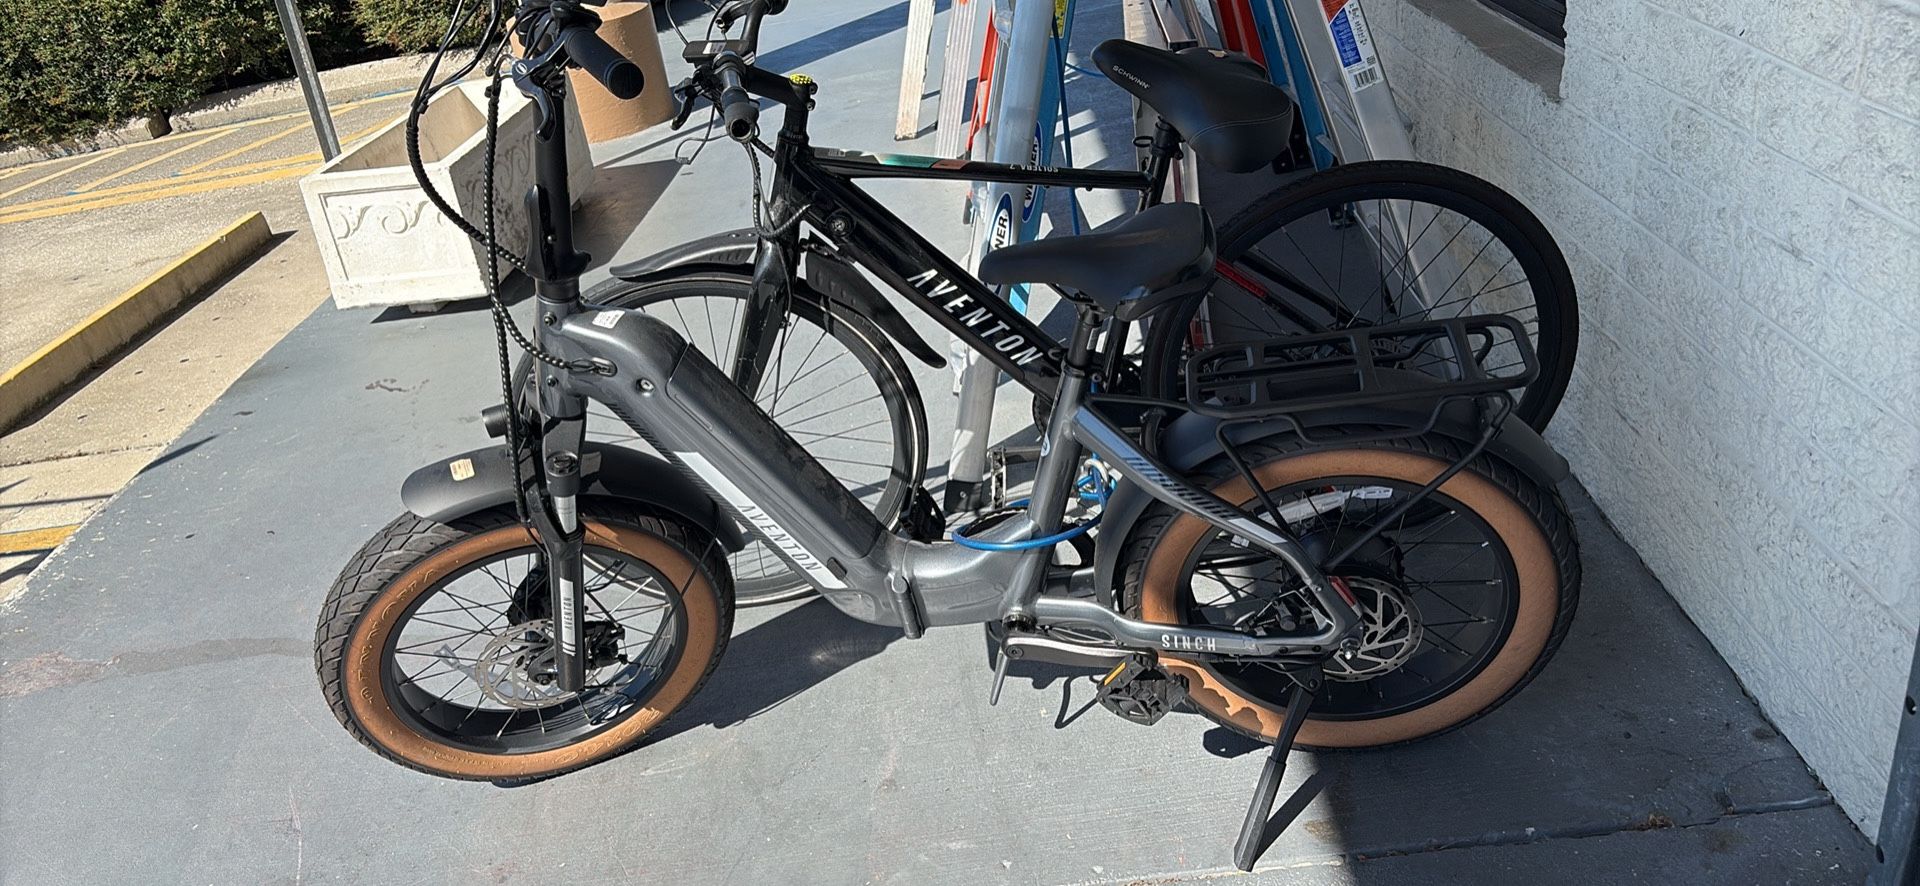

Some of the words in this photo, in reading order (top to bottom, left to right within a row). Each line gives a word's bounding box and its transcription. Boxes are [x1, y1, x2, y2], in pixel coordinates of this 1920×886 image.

[1112, 65, 1149, 89] SCHWINN
[994, 216, 1008, 249] NER
[906, 268, 1044, 367] AVENTON
[737, 505, 822, 571] AVENTON
[563, 596, 573, 631] AVENTON
[1161, 634, 1216, 652] SINCH
